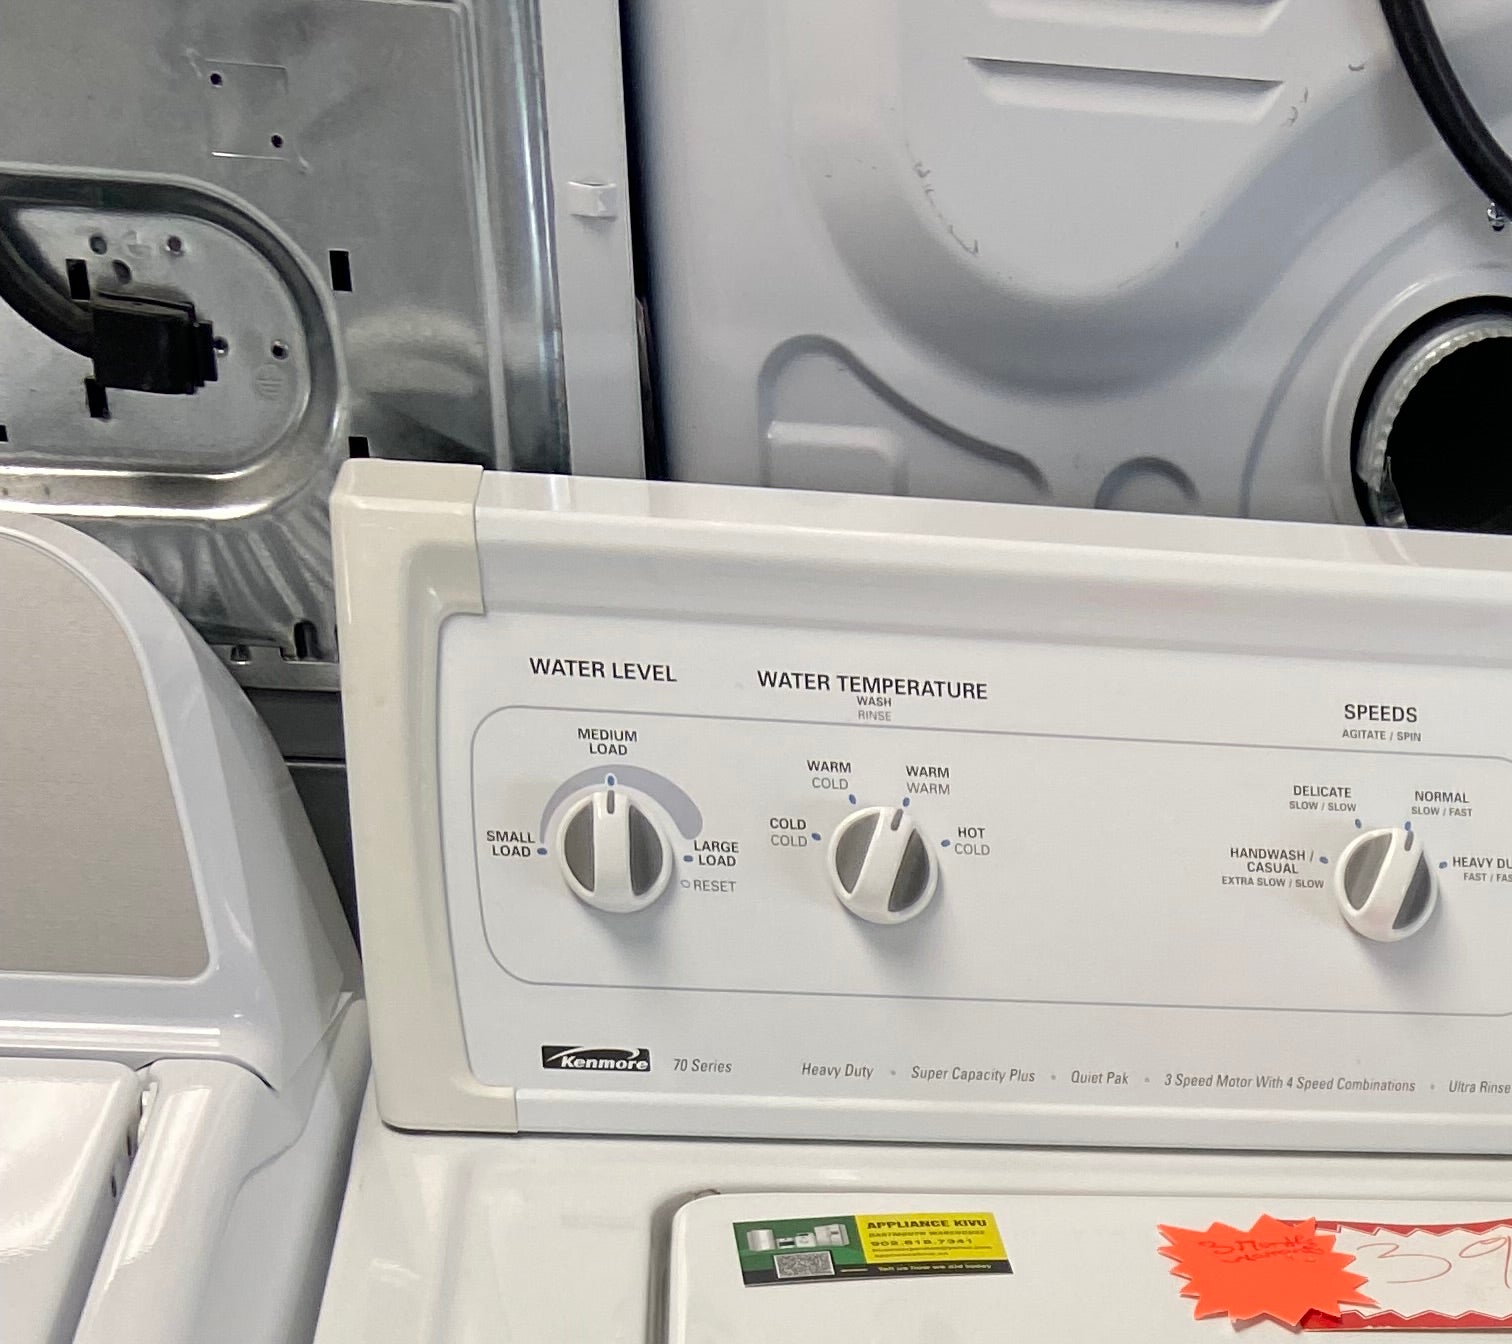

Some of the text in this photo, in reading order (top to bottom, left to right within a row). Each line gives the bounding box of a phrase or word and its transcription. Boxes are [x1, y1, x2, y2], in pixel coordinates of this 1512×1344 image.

[529, 657, 678, 683] WATER LEVEL
[757, 670, 988, 699] WATER TEMPERATURE
[856, 696, 892, 708] WASH
[858, 710, 891, 722] RINSE
[1344, 704, 1418, 723] SPEEDS
[577, 728, 637, 742] MEDIUM
[1342, 730, 1421, 742] AGITATE / SPIN
[589, 743, 628, 757] LOAD
[807, 760, 852, 774] WARM
[905, 765, 950, 779] WARM
[812, 777, 849, 790] COLD
[906, 781, 950, 795] WARM
[1293, 785, 1352, 798] DELICATE
[1414, 791, 1469, 803] NORMAL
[1289, 800, 1319, 811] SLOW
[1328, 802, 1356, 813] SLOW
[1411, 806, 1441, 816] SLOW
[1449, 807, 1472, 817] FAST
[770, 817, 807, 830] COLD
[486, 830, 536, 844] SMALL
[958, 826, 985, 839] HOT
[694, 840, 739, 854] LARGE
[770, 834, 808, 847] COLD
[492, 844, 531, 857] LOAD
[954, 843, 990, 856] COLD
[1230, 847, 1306, 861] HANDWASH
[698, 854, 736, 867] LOAD
[1452, 856, 1493, 869] HEAVY
[1247, 862, 1298, 874] CASUAL
[1222, 876, 1254, 886] EXTRA
[1257, 877, 1286, 887] SLOW
[1295, 878, 1324, 889] SLOW
[1463, 872, 1488, 882] FAST
[693, 879, 736, 892] RESET
[561, 1056, 649, 1070] Kenmore
[673, 1059, 732, 1073] 70 Series
[802, 1063, 873, 1079] Heavy Duty
[911, 1066, 1035, 1083] Super Capacity Plus
[1071, 1071, 1129, 1085] Quiet Pak
[1164, 1074, 1416, 1092] 3 Speed Motor With 4 Speed Combinations
[1448, 1081, 1476, 1093] Ultra
[1480, 1082, 1511, 1094] Rinse
[868, 1220, 950, 1229] APPLIANCE
